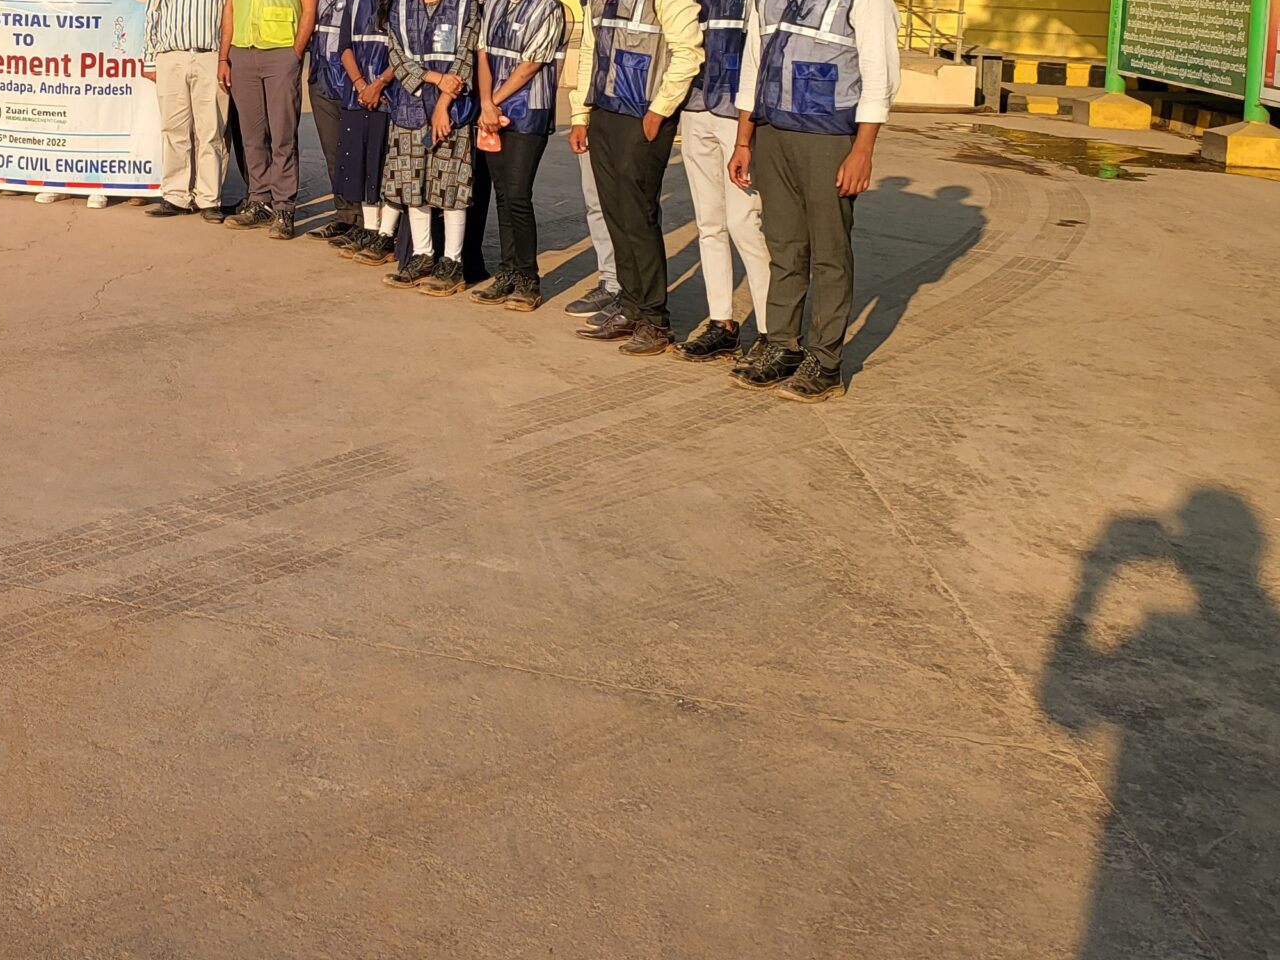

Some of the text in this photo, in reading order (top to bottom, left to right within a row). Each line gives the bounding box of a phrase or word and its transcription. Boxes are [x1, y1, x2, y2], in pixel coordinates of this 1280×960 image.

[56, 14, 102, 29] VISIT
[12, 32, 34, 47] TO
[39, 83, 81, 95] Andhra
[85, 84, 133, 96] Pradesh
[5, 106, 67, 118] Zuari Cement
[8, 134, 45, 146] December
[47, 138, 67, 147] 2022
[17, 156, 51, 172] CIVIL
[55, 158, 152, 175] ENGINEERING
